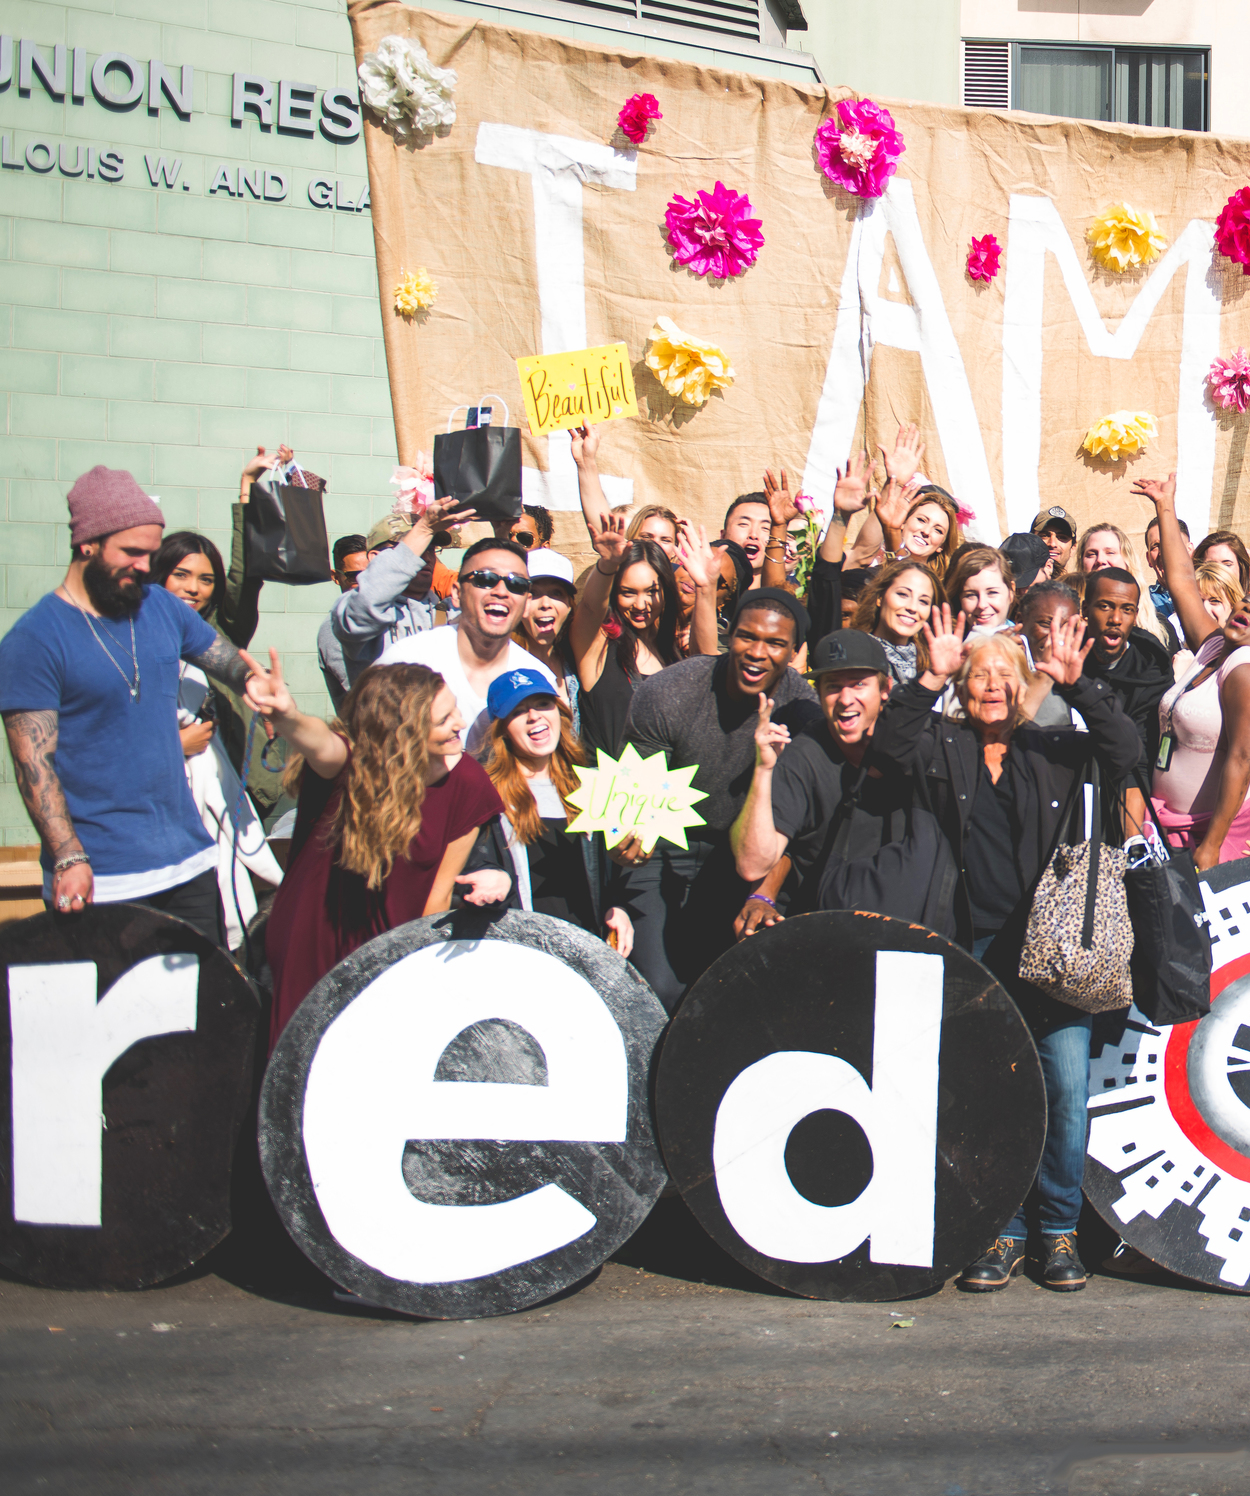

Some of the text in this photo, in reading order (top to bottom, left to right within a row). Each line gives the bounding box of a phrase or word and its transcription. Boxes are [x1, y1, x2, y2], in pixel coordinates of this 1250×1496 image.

[1, 135, 124, 181] LOUIS
[145, 154, 190, 191] W.
[210, 165, 288, 200] AND
[802, 176, 1222, 540] AM
[526, 362, 630, 428] Beautiful
[588, 774, 685, 826] Unique
[8, 938, 945, 1284] red
